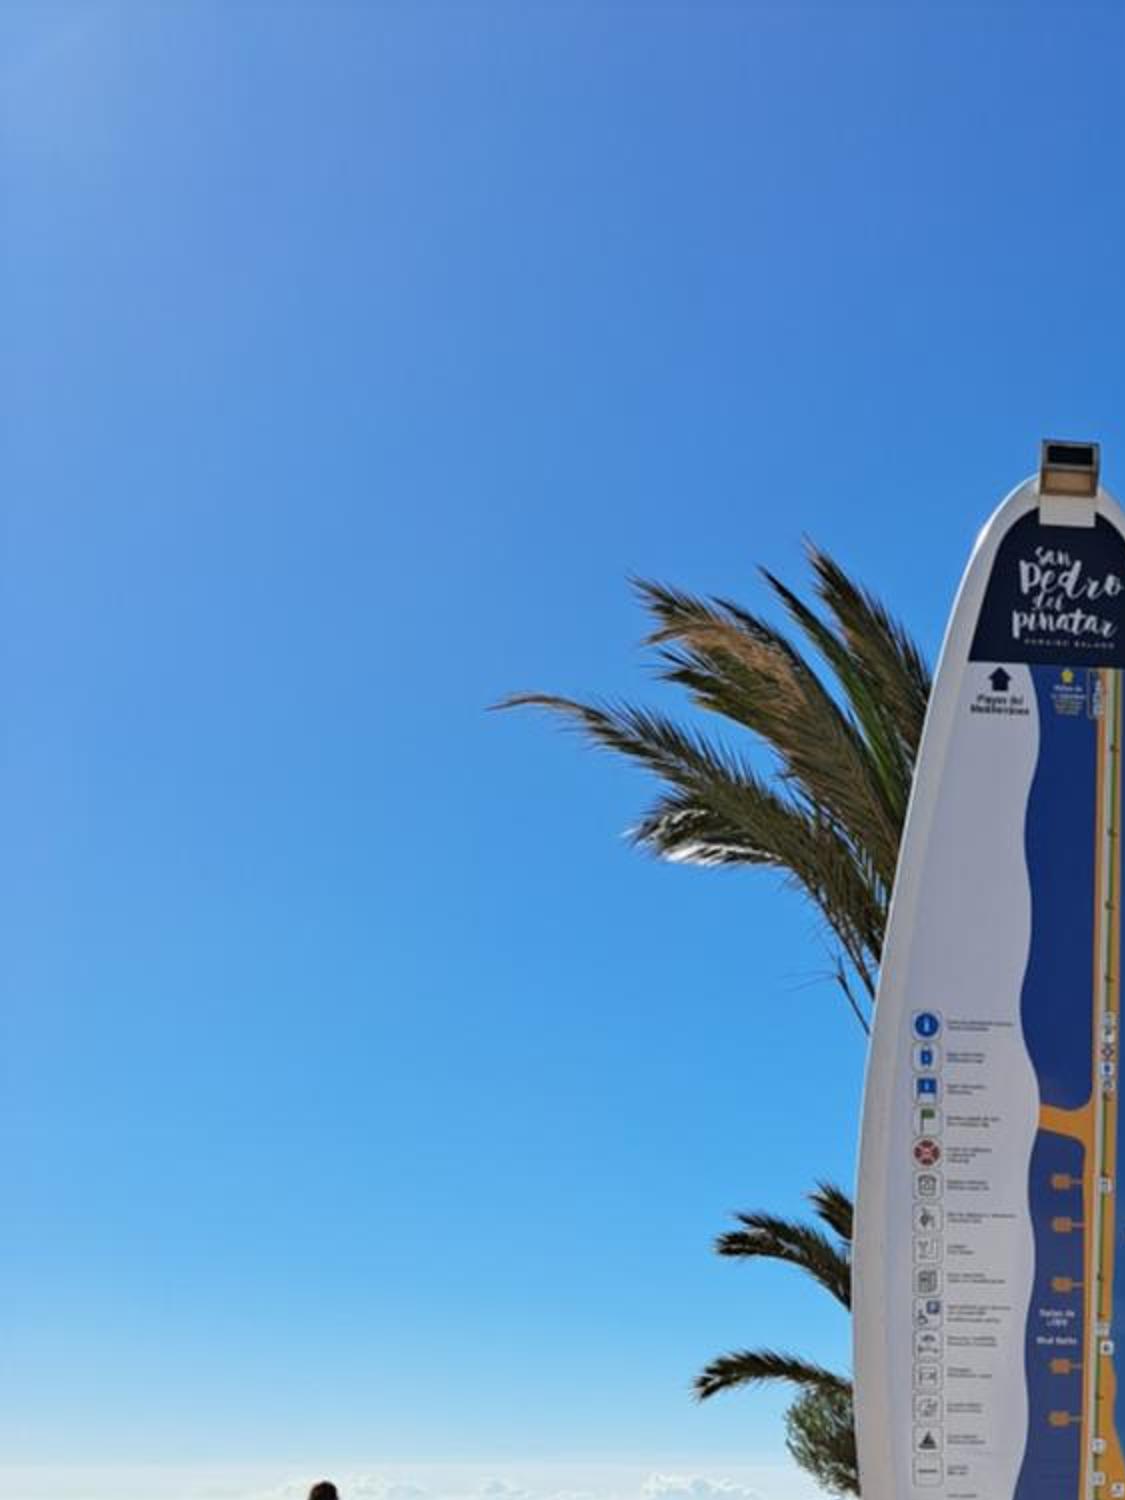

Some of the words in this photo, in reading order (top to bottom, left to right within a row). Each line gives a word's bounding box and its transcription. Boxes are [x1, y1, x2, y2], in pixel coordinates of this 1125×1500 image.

[1033, 546, 1071, 567] san
[1018, 559, 1124, 599] Pedro
[1012, 608, 1118, 639] pinatar
